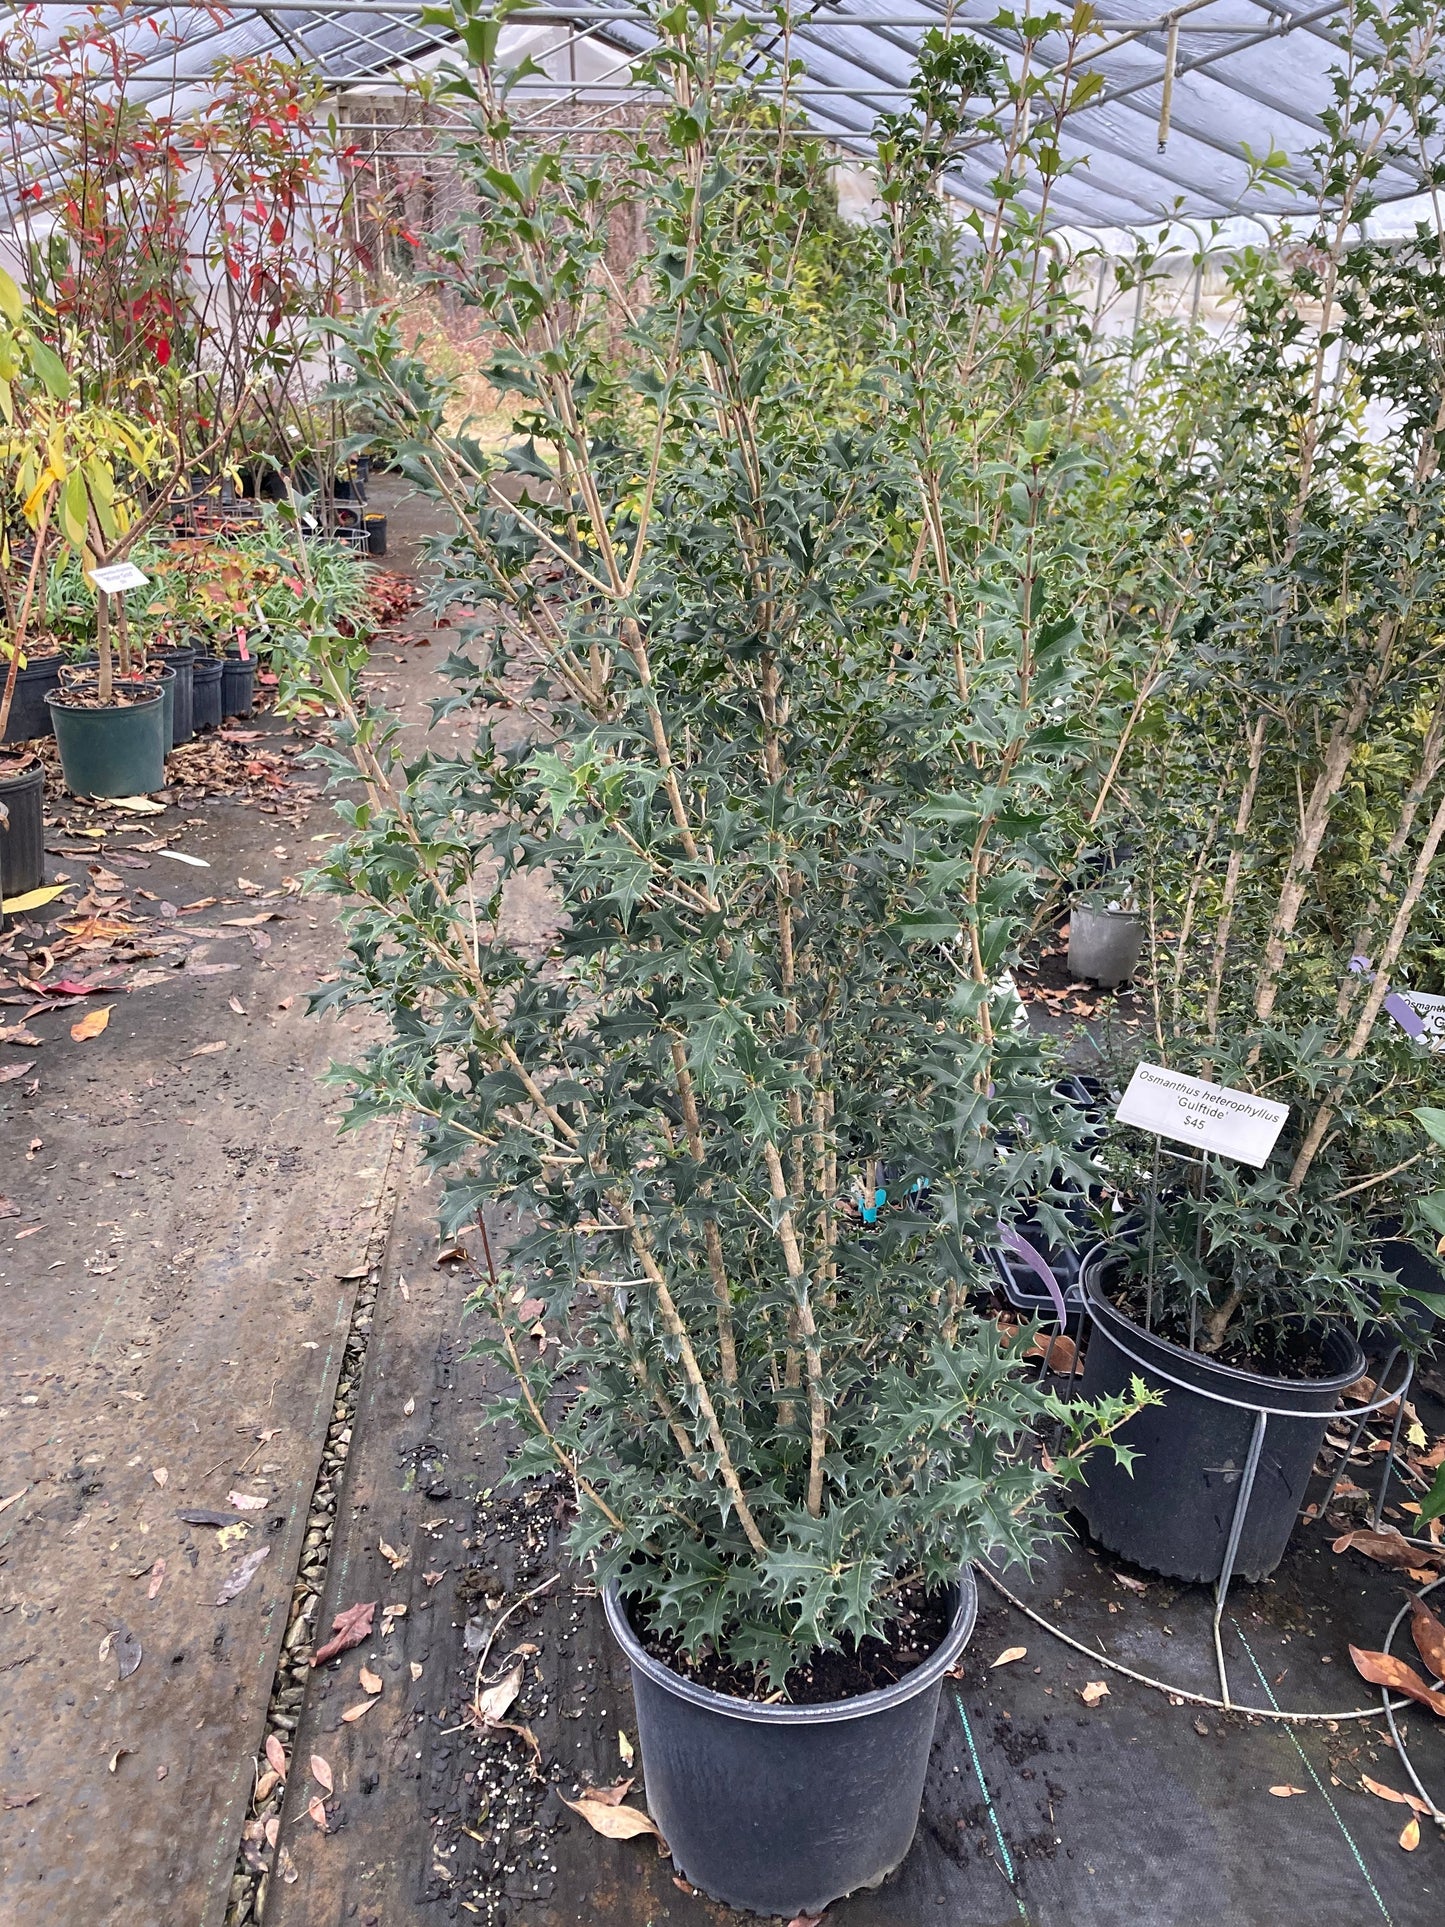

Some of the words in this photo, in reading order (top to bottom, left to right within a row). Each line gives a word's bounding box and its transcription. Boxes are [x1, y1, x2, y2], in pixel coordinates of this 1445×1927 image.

[1139, 1070, 1200, 1097] Osmanthus
[1202, 1090, 1280, 1123] heterophyllus
[1177, 1095, 1229, 1120] 'Gulftide'
[1183, 1115, 1205, 1130] $45
